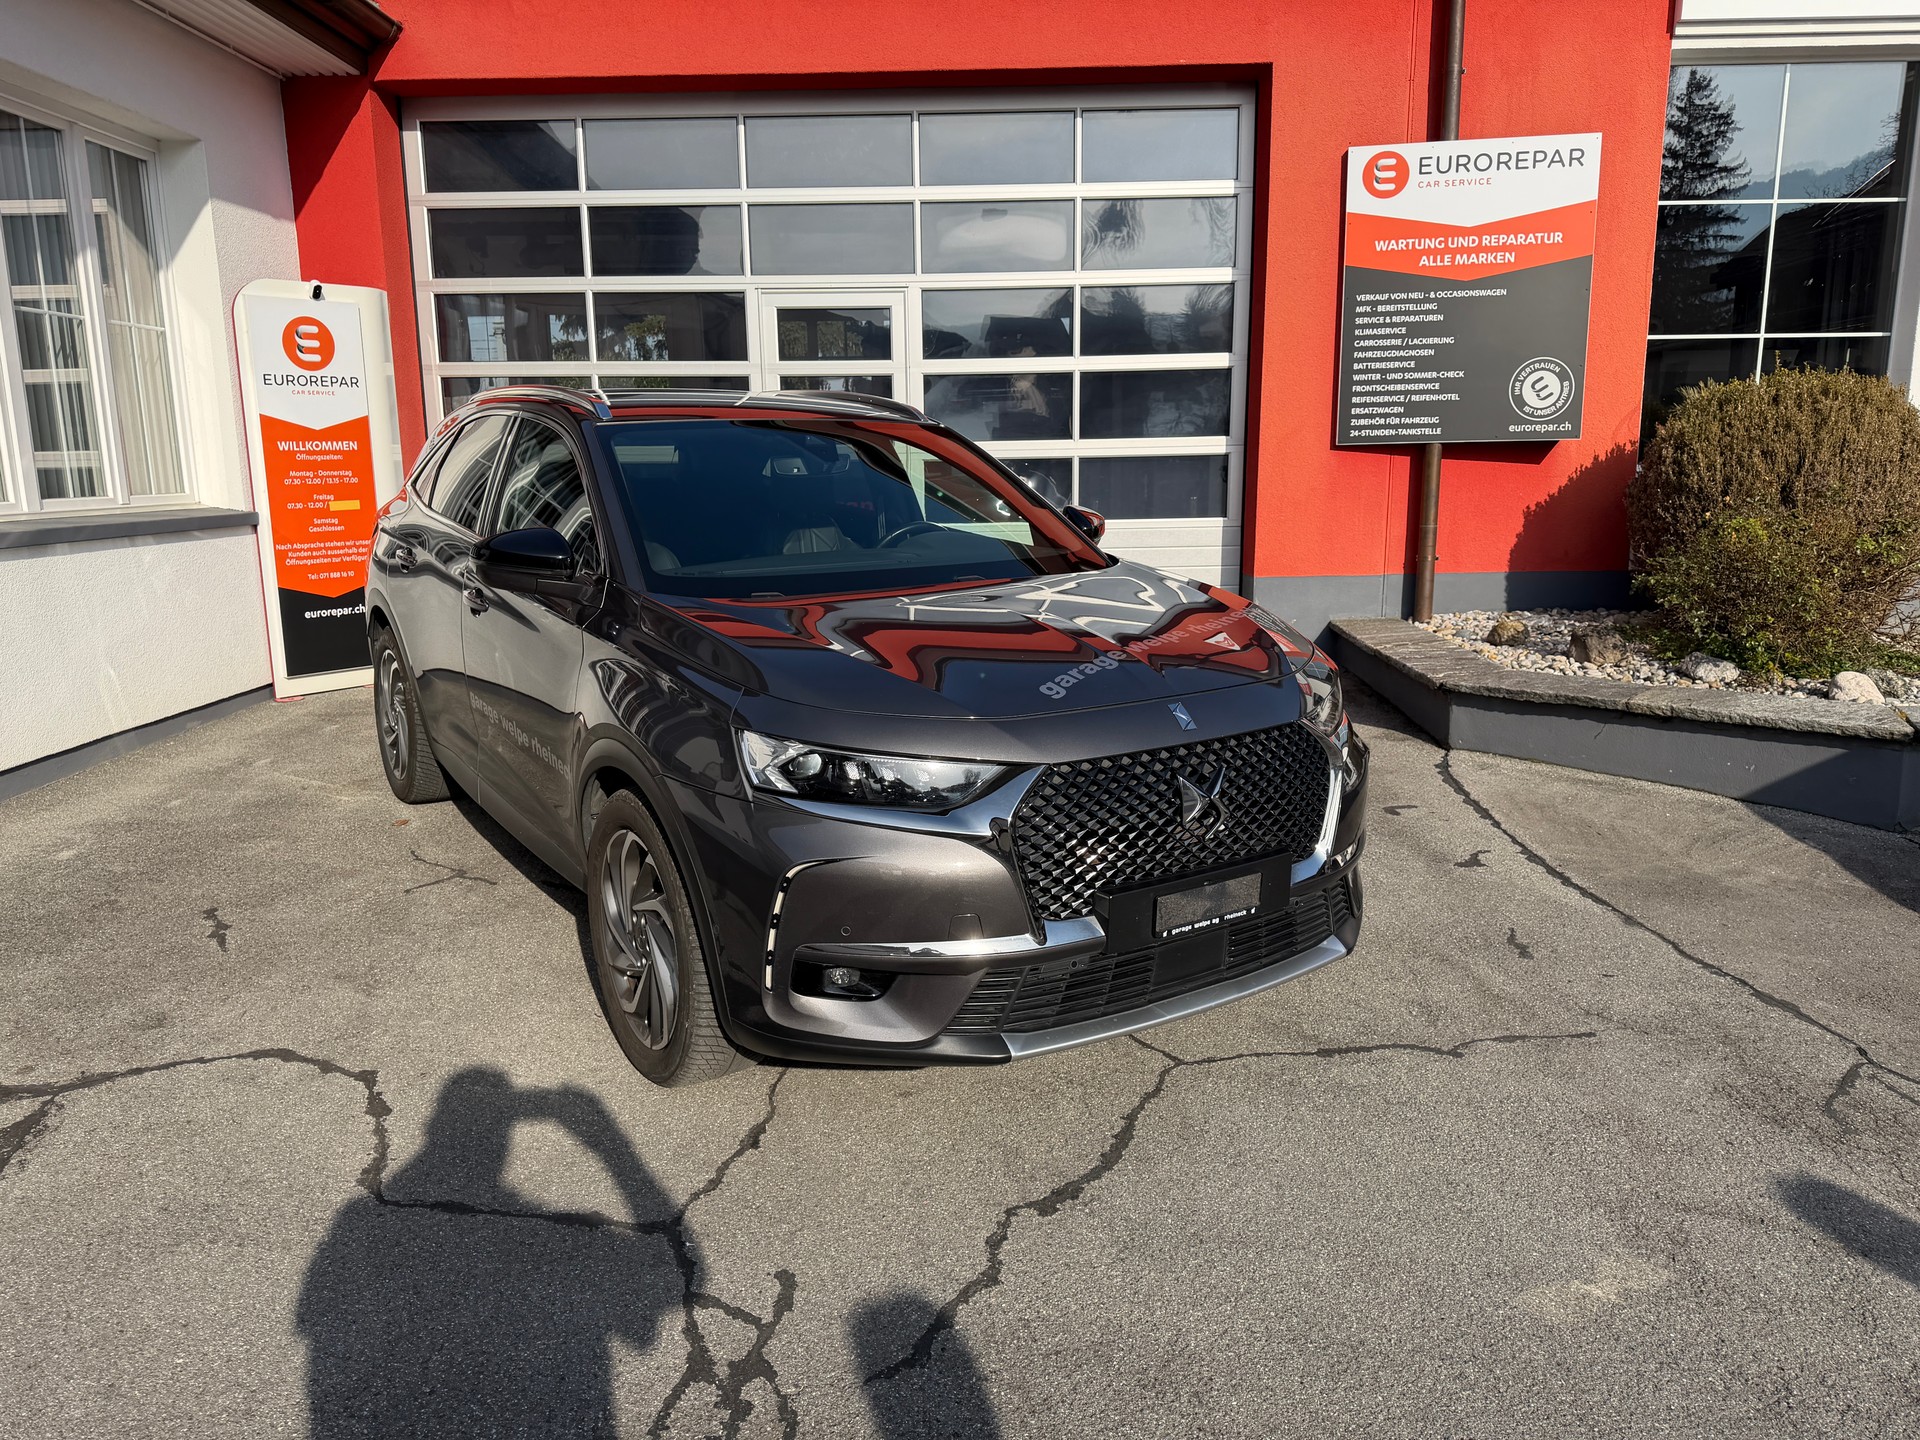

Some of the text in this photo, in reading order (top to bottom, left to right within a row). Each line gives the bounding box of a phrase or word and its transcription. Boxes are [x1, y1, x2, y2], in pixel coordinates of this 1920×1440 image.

[1419, 148, 1585, 175] EUROREPAR
[1418, 177, 1492, 189] CAR SERVICE
[1374, 232, 1563, 251] WARTUNG UND REPARATUR
[1419, 251, 1515, 267] ALLE MARKEN
[1356, 293, 1389, 301] VERKAUF
[1390, 292, 1407, 300] VON
[1408, 291, 1424, 300] NEU
[1429, 291, 1436, 299] &
[1436, 289, 1507, 299] OCCASIONSWAGEN
[1356, 305, 1372, 313] MFK
[1377, 302, 1438, 312] BEREITSTELLUNG
[1355, 314, 1444, 325] SERVICE & REPARATUREN
[1355, 327, 1407, 336] KLIMASERVICE
[1354, 338, 1402, 347] CARROSSERIE
[1408, 336, 1455, 345] LACKIERUNG
[1354, 349, 1435, 359] FAHRZEUGDIAGNOSEN
[1353, 361, 1415, 370] BATTERIESERVICE
[263, 374, 360, 388] EUROREPAR
[1353, 373, 1381, 381] WINTER
[1386, 372, 1403, 380] UND
[1404, 370, 1465, 380] SOMMER-CHECK
[1514, 362, 1561, 395] IHR VERTRAUEN
[1352, 382, 1440, 393] FRONTSCHEIBENSERVICE
[1351, 395, 1405, 404] REIFENSERVICE
[1411, 393, 1460, 402] REIFENHOTEL
[1523, 380, 1569, 416] IST UNSER ANTRIEB
[1351, 406, 1404, 415] ERSATZWAGEN
[1350, 416, 1440, 426] ZUBEHÖR FÜR FAHRZEUG
[1349, 427, 1442, 437] 24-STUNDEN-TANKSTELLE
[1508, 421, 1572, 433] eurorepar.ch
[277, 441, 358, 451] WILLKOMMEN
[296, 453, 343, 461] Öffnungszeiten:
[285, 558, 331, 566] Öffnungszeiten
[304, 603, 366, 619] eurorepar.ch
[1039, 649, 1127, 699] garage
[1126, 628, 1185, 653] welpe
[1187, 608, 1246, 634] rheine
[470, 691, 499, 724] garage
[500, 715, 529, 747] welpe
[1171, 925, 1192, 935] garage
